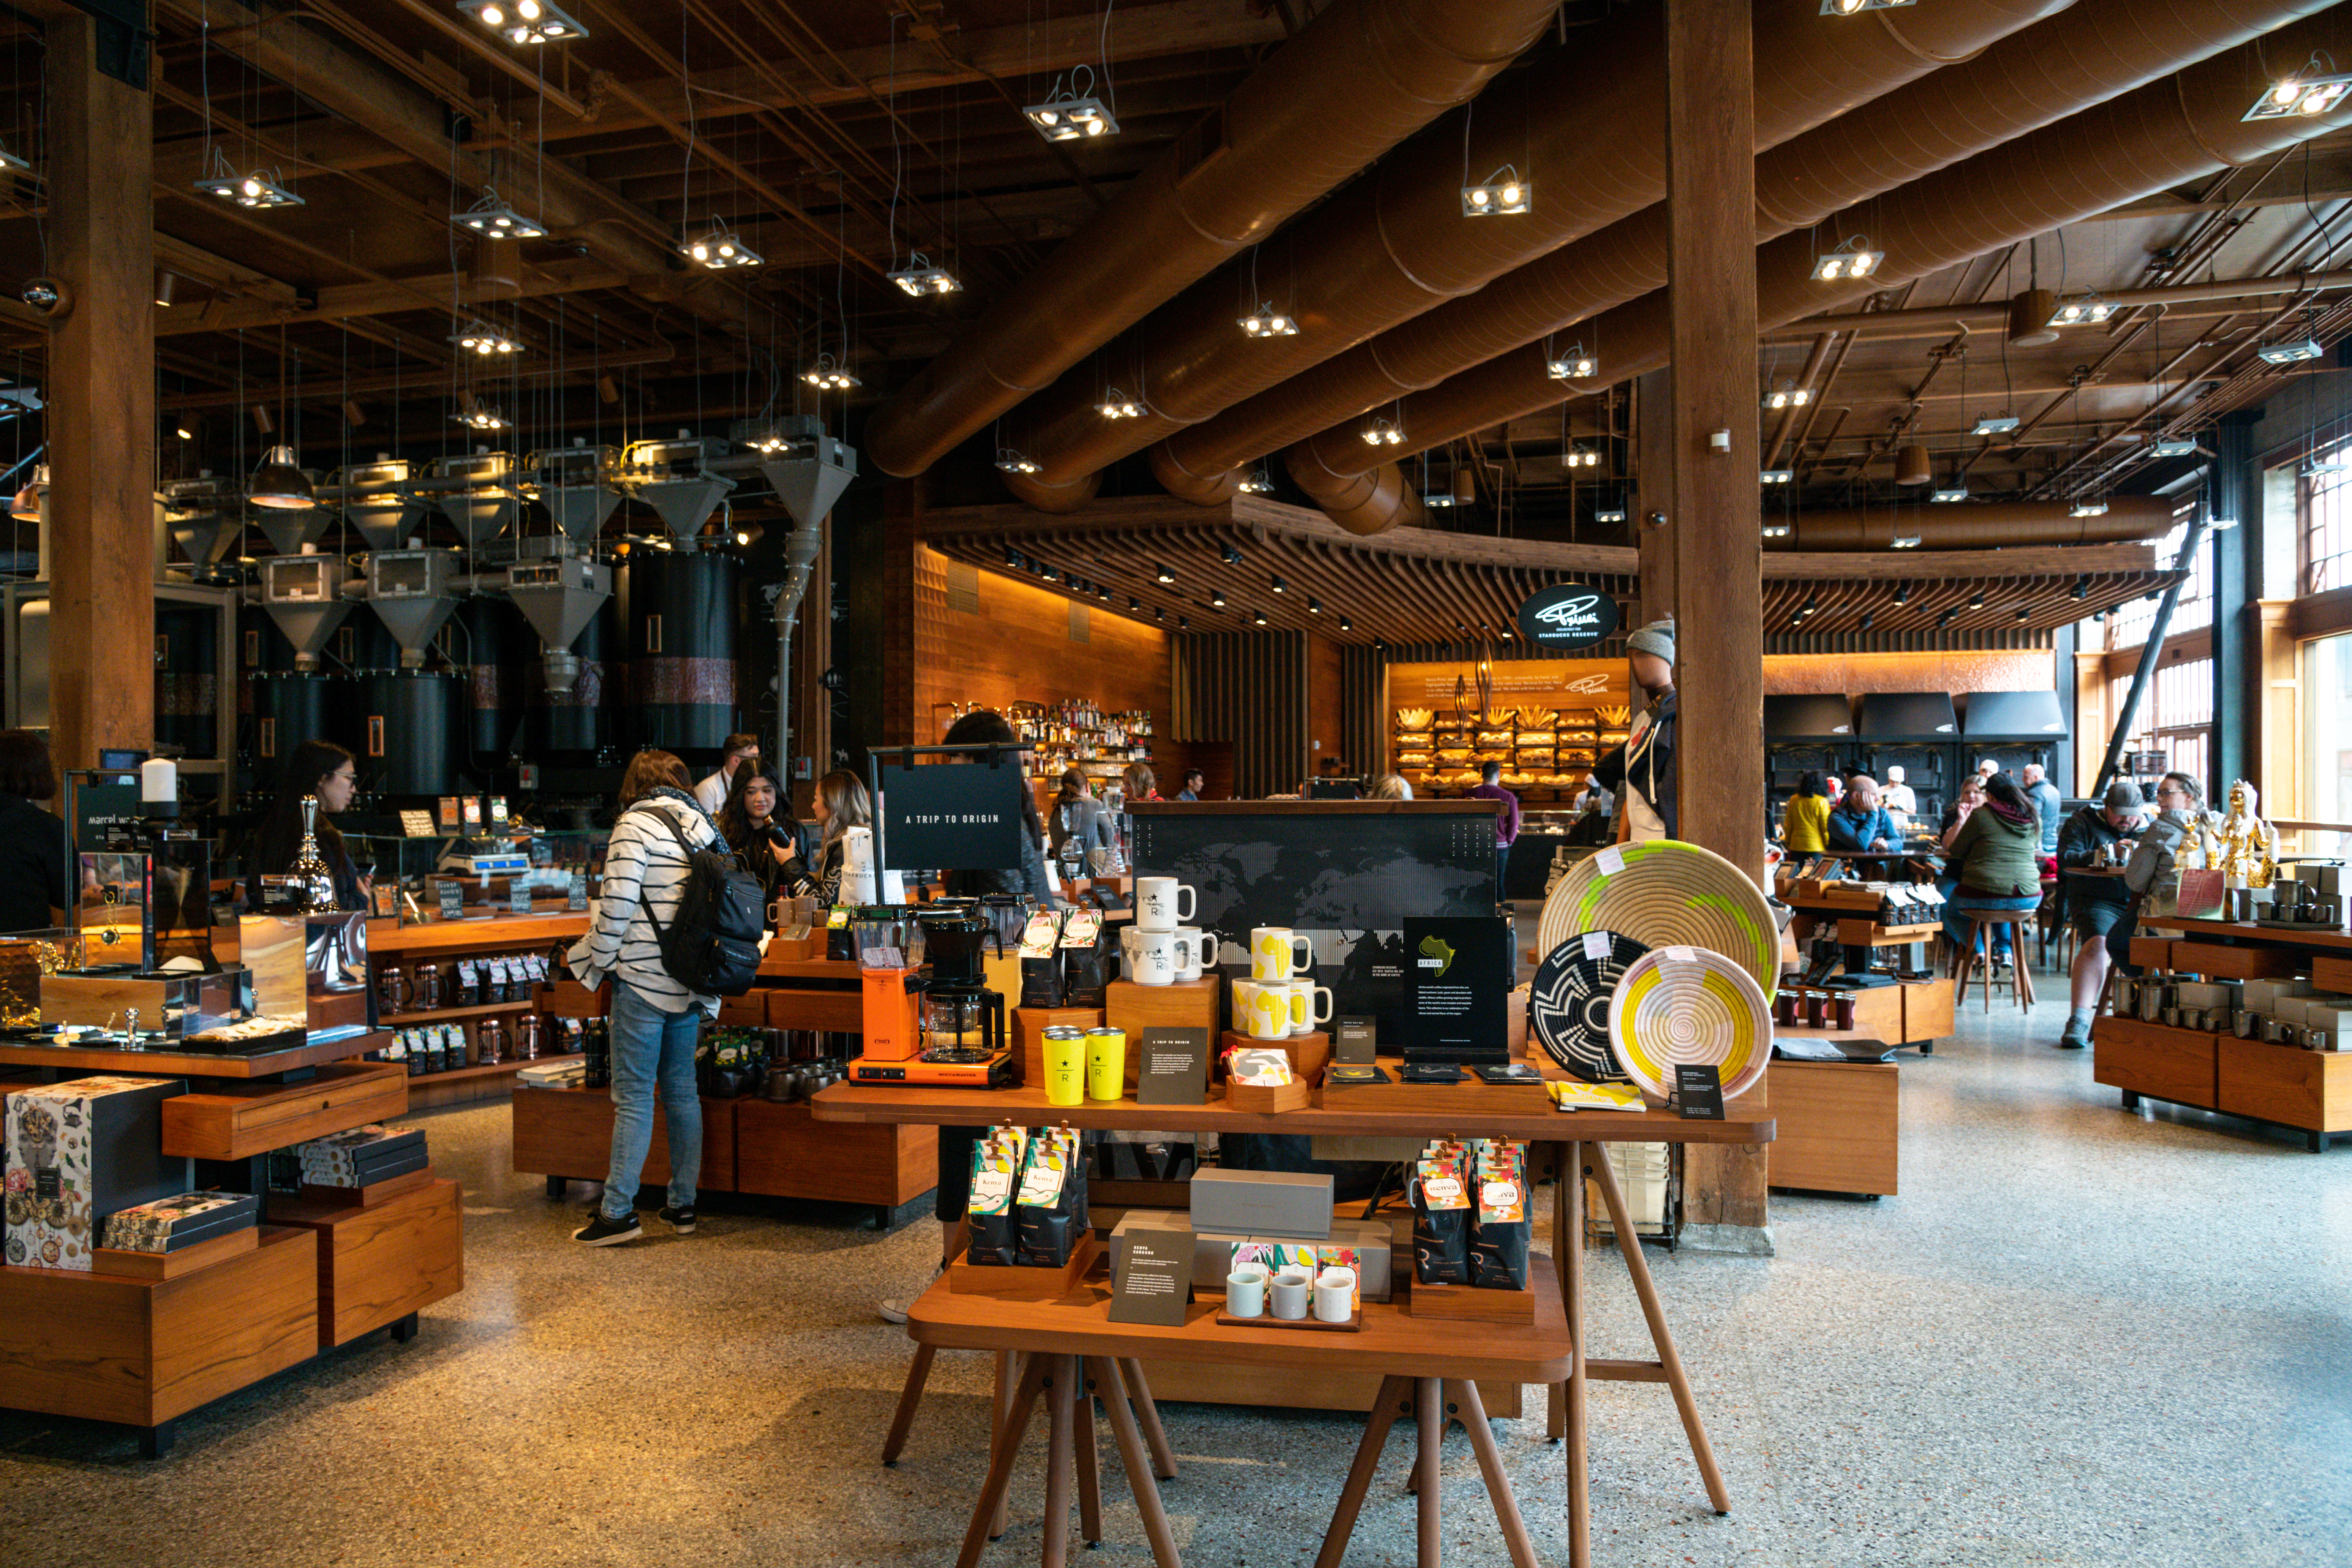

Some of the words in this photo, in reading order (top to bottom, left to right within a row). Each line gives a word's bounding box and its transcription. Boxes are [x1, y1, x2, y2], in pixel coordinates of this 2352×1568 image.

[89, 814, 115, 825] marcel
[917, 815, 939, 824] TRIP
[963, 815, 998, 823] ORIGIN
[1418, 1248, 1429, 1270] R
